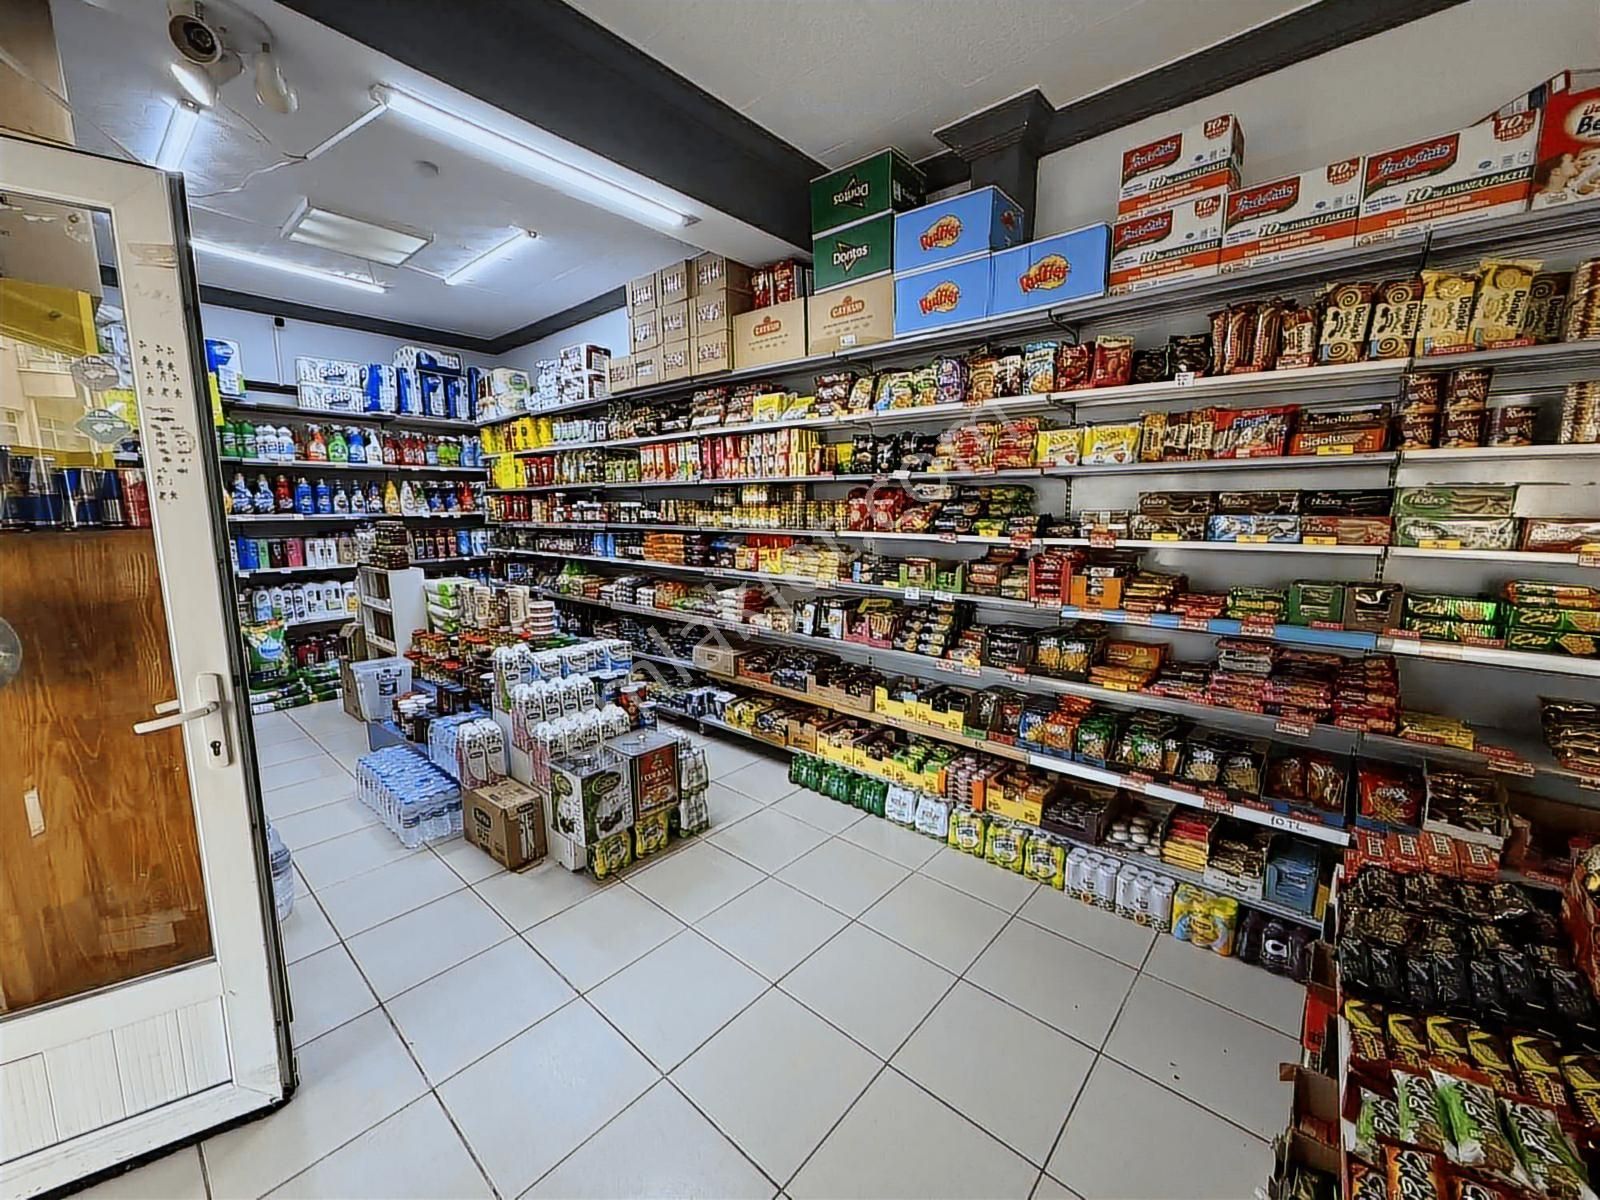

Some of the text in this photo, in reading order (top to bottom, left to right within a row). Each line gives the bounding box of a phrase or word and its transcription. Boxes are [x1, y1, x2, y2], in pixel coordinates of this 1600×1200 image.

[833, 244, 869, 265] Doritos
[319, 364, 348, 378] Solo
[325, 389, 352, 403] Solo
[1232, 413, 1272, 430] Finger
[1299, 431, 1344, 449] bidolu
